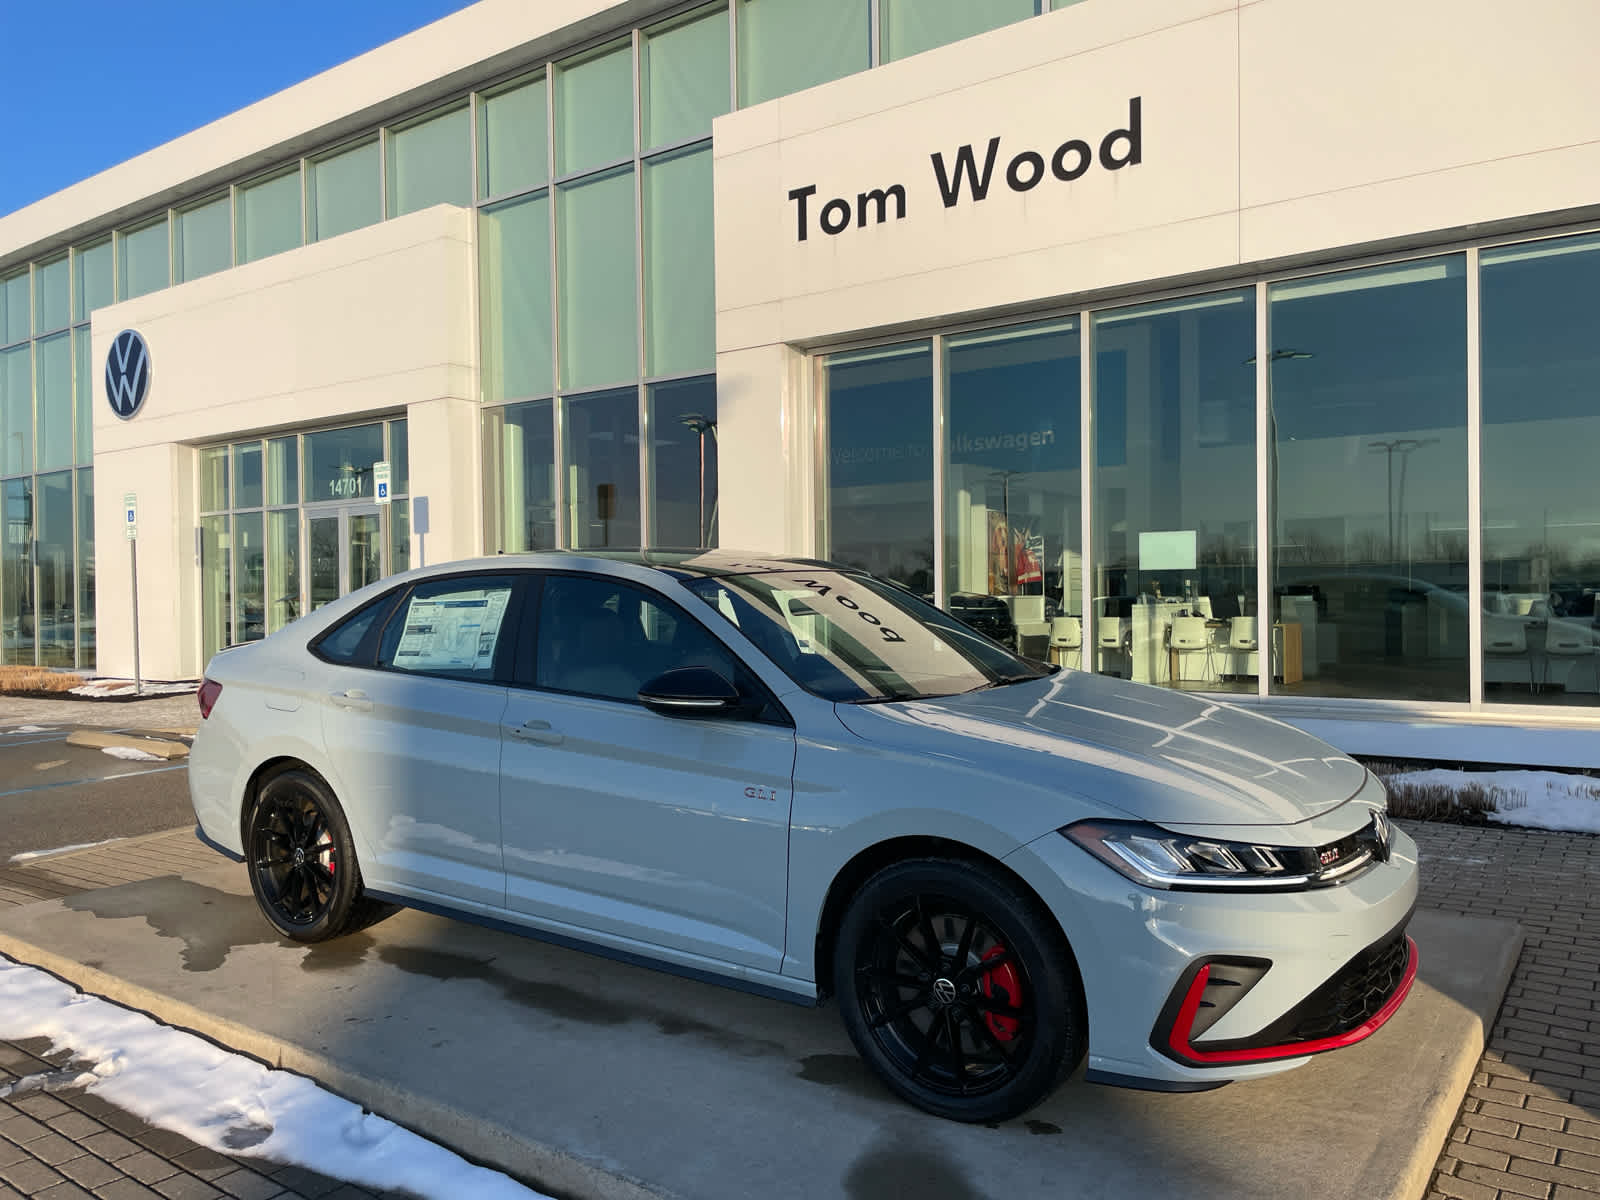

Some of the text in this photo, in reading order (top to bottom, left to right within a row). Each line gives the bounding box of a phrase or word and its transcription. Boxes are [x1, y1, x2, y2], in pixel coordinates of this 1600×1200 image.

[788, 96, 1143, 242] Tom Wood
[105, 329, 150, 420] VW
[329, 474, 362, 497] 14701
[743, 786, 777, 801] GLI
